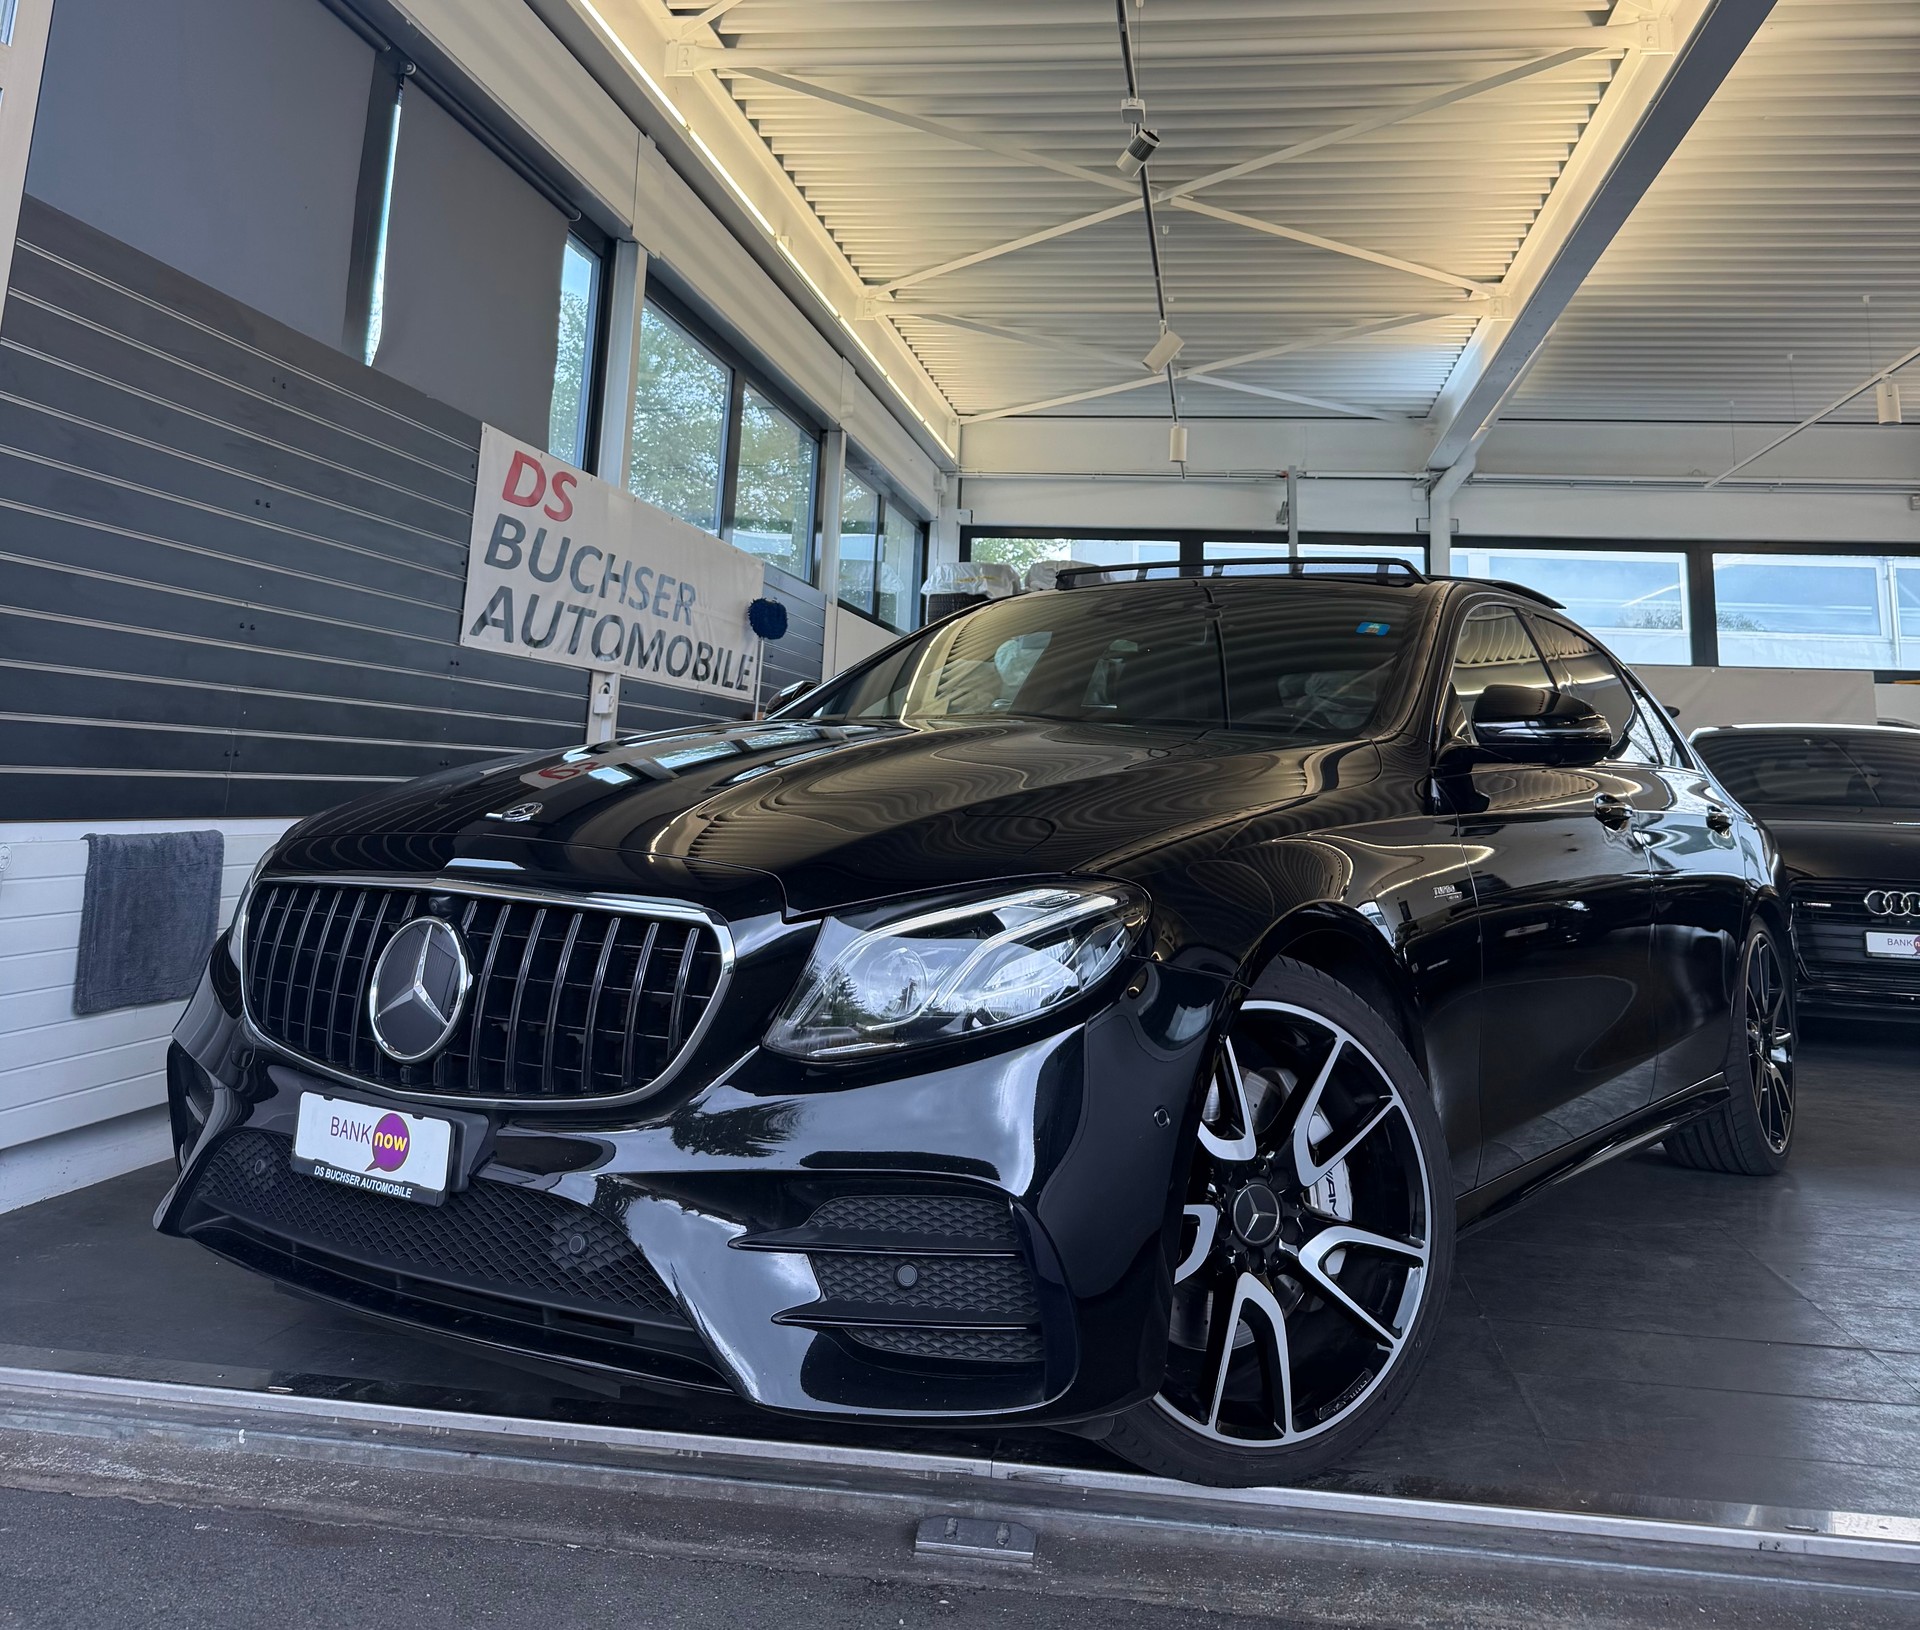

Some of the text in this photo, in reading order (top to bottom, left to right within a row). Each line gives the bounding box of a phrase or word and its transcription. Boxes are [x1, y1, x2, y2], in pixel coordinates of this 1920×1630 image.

[502, 450, 577, 522] DS
[484, 513, 696, 626] BUCHSER
[469, 585, 754, 691] AUTOMOBILE
[1887, 938, 1913, 946] BANK
[330, 1116, 372, 1145] BANK
[374, 1131, 407, 1152] now
[314, 1165, 413, 1198] DS BUCHSER AUTOMOBILE
